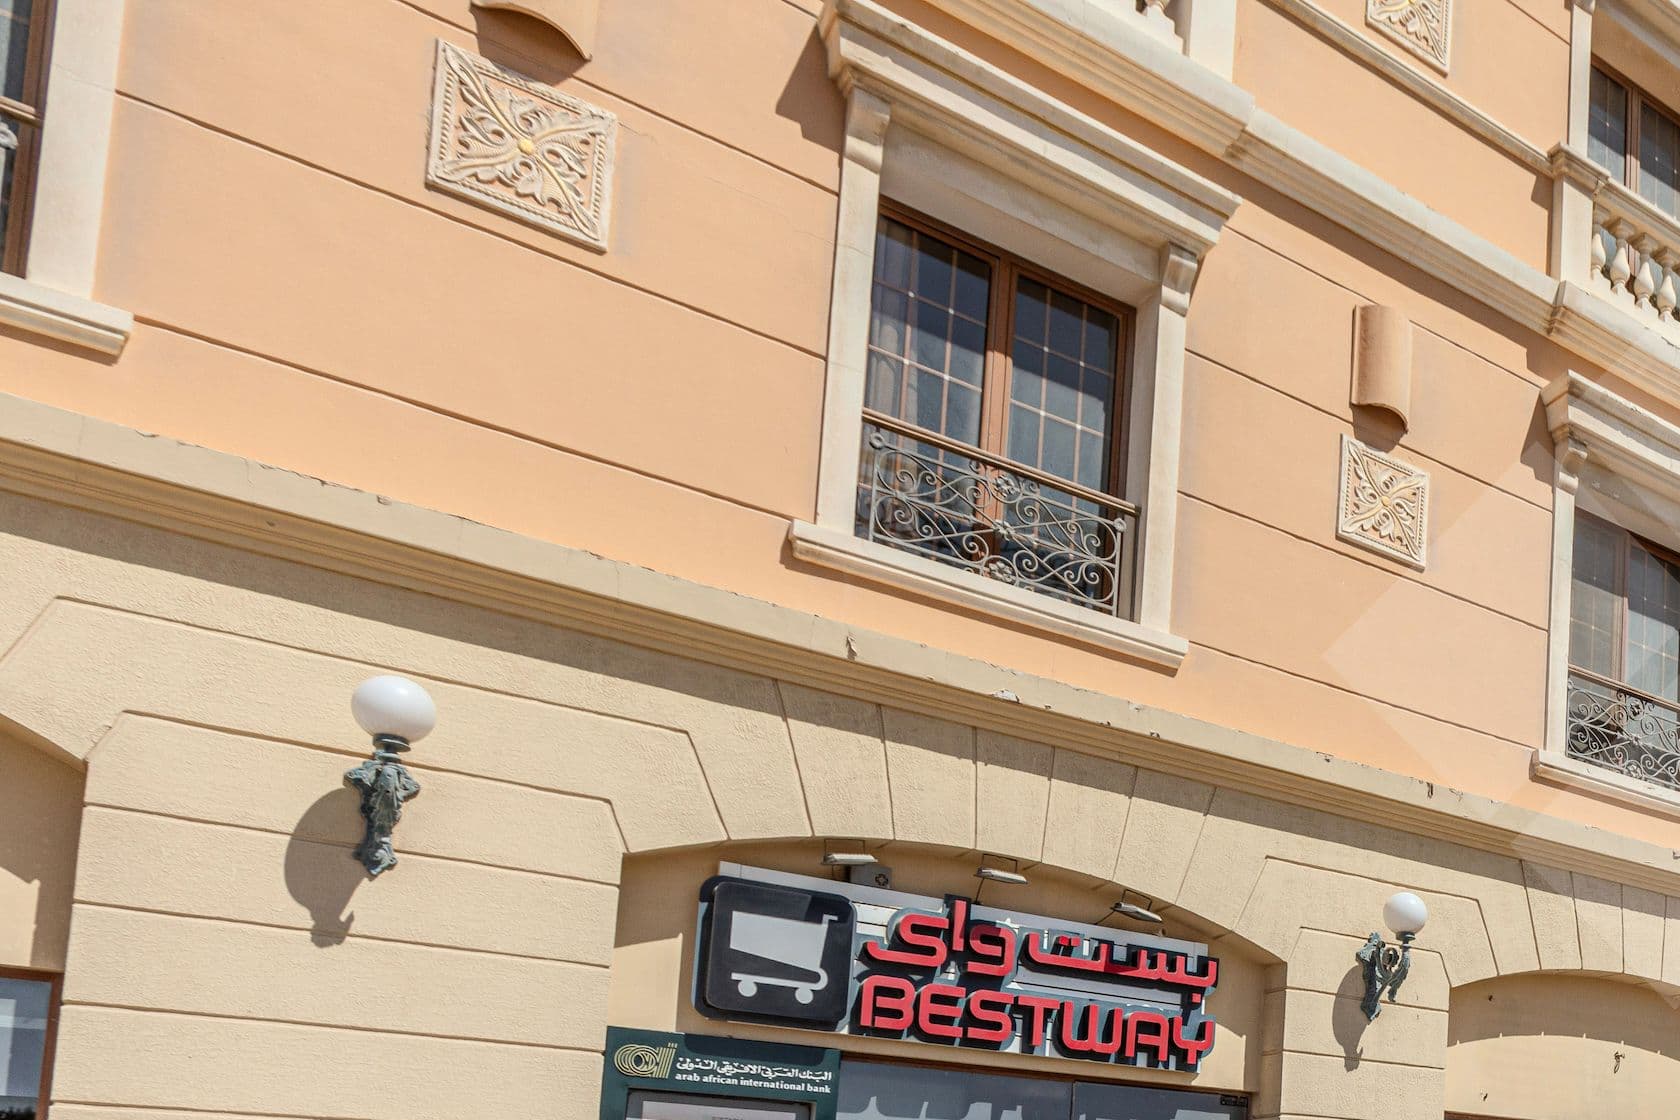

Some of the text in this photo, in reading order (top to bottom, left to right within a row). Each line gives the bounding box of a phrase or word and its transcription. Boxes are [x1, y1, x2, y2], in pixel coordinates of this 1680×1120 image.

[859, 974, 1215, 1065] BESTWAY
[675, 1073, 832, 1094] arab african international bank
